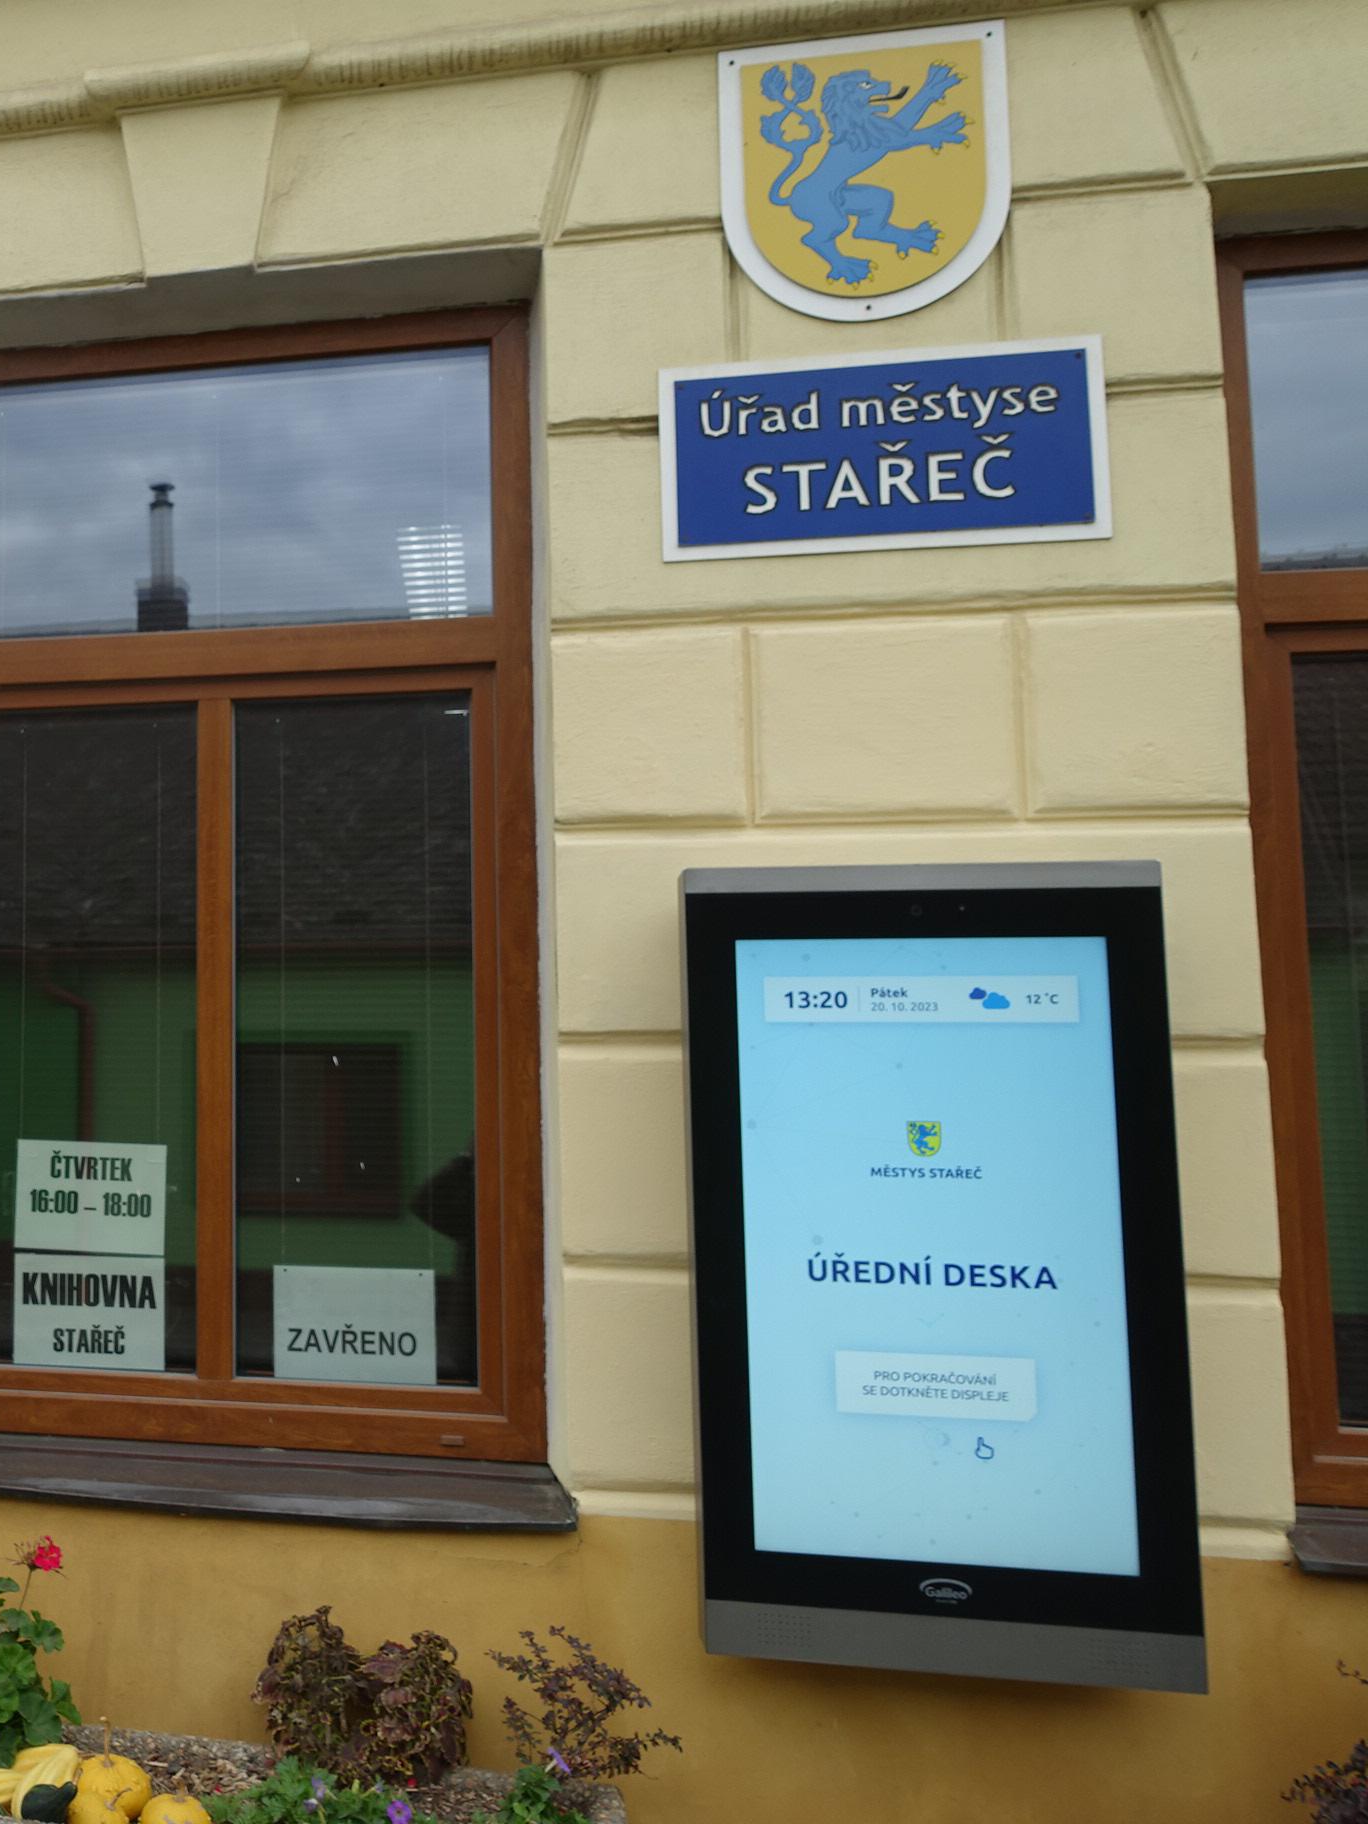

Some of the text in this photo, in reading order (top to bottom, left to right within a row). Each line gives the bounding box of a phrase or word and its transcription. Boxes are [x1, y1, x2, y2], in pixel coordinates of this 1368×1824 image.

[699, 381, 1059, 438] Úřad městyse
[743, 432, 1016, 514] STAŘEČ
[784, 990, 849, 1009] 13:20
[871, 986, 908, 999] Pátek
[910, 1001, 939, 1012] 2023
[1026, 993, 1042, 1005] 12
[49, 1150, 133, 1182] ČTVRTEK
[870, 1163, 983, 1180] MĚSTYS STAŘEČ
[29, 1189, 79, 1215] 16:00
[102, 1192, 152, 1218] 18:00
[807, 1252, 1058, 1290] ÚŘEDNÍ DESKA
[22, 1272, 157, 1310] KNIHOVNA
[52, 1324, 126, 1356] STAŘEČ
[287, 1323, 417, 1357] ZAVŘENO
[873, 1370, 997, 1386] PRO POKRAČOVÁNÍ
[862, 1384, 1009, 1402] SE DOTKNĚTE DISPLEJE
